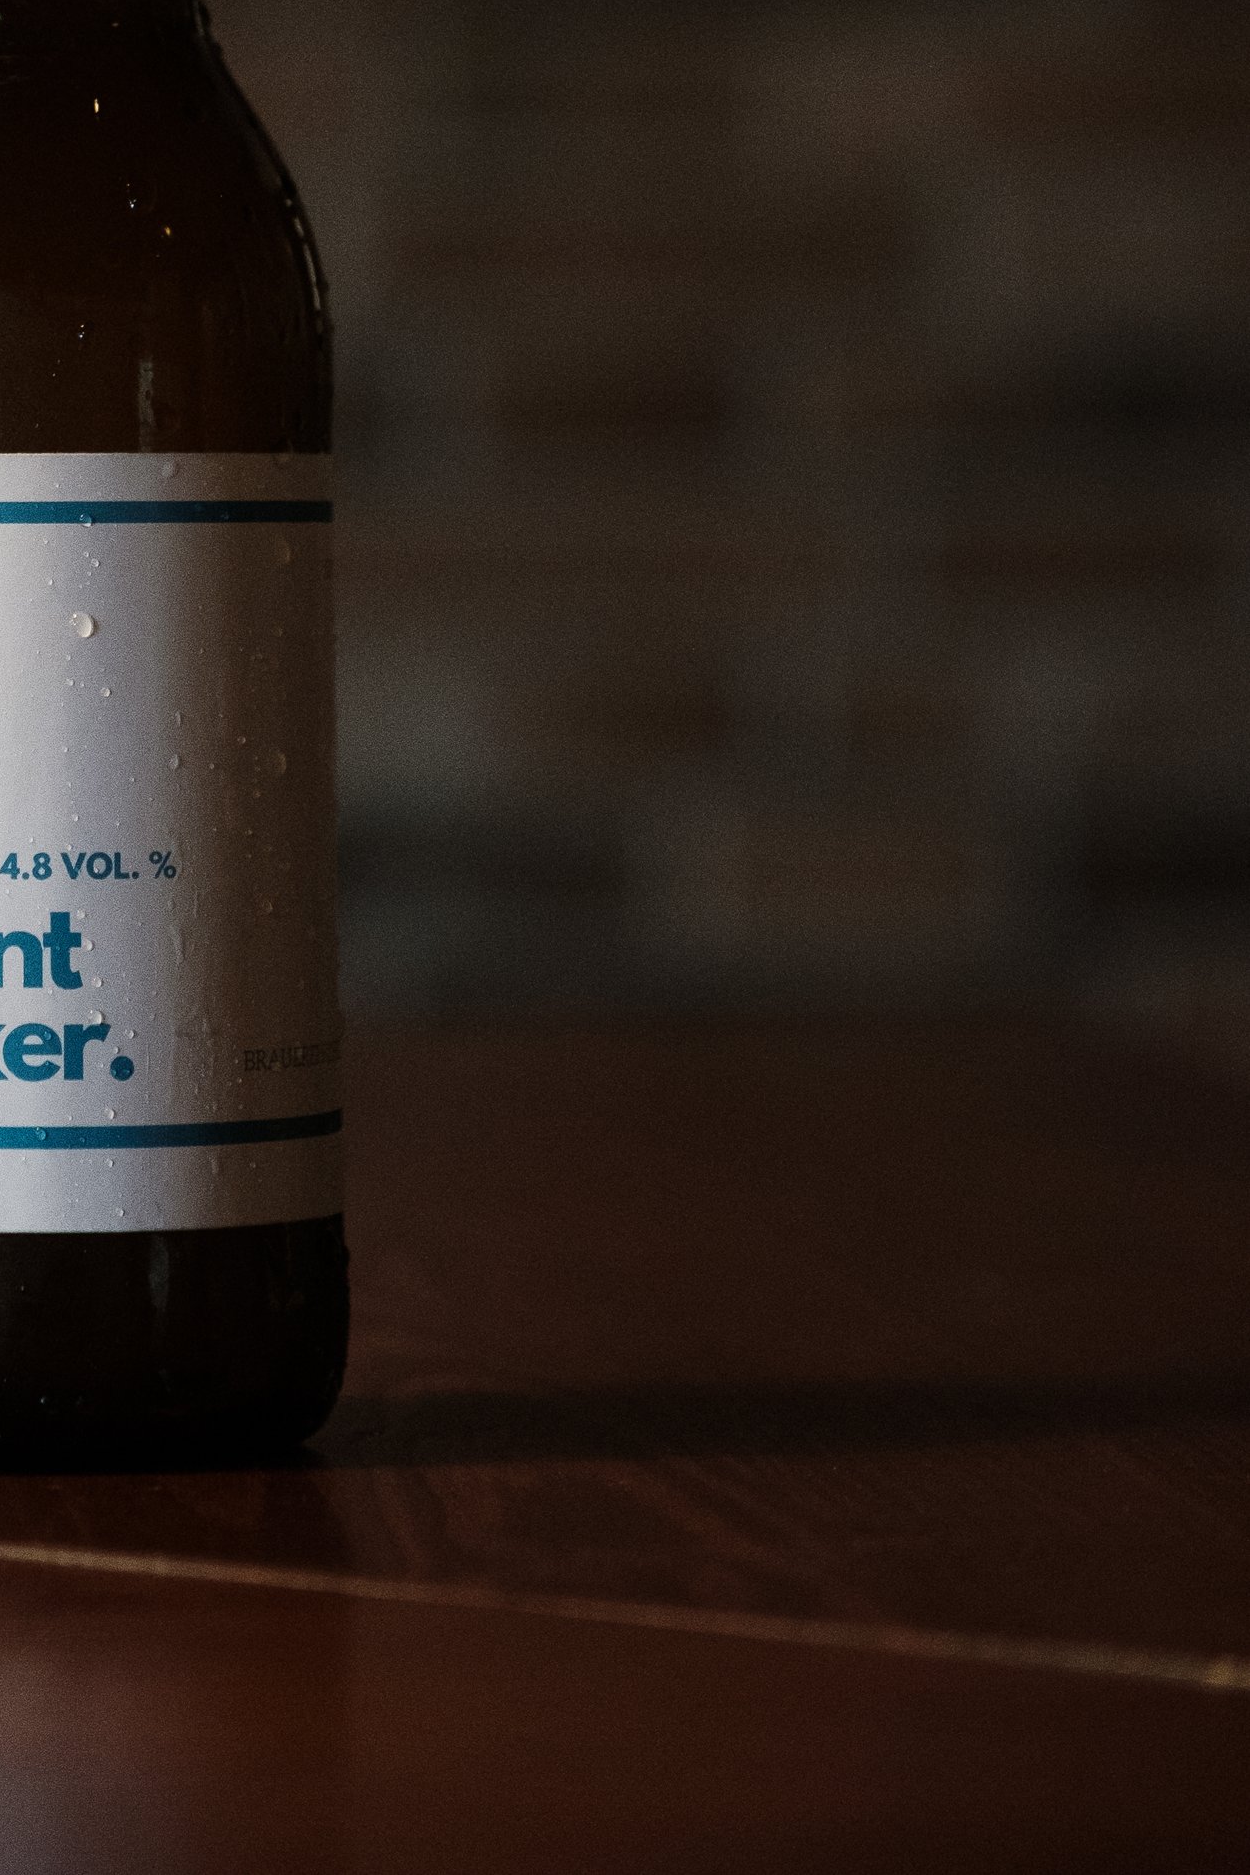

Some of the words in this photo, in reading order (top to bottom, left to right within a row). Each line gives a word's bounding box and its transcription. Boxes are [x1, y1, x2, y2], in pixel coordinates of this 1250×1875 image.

[0, 852, 53, 880] 4.8
[61, 851, 140, 880] VOL.
[149, 850, 178, 880] %
